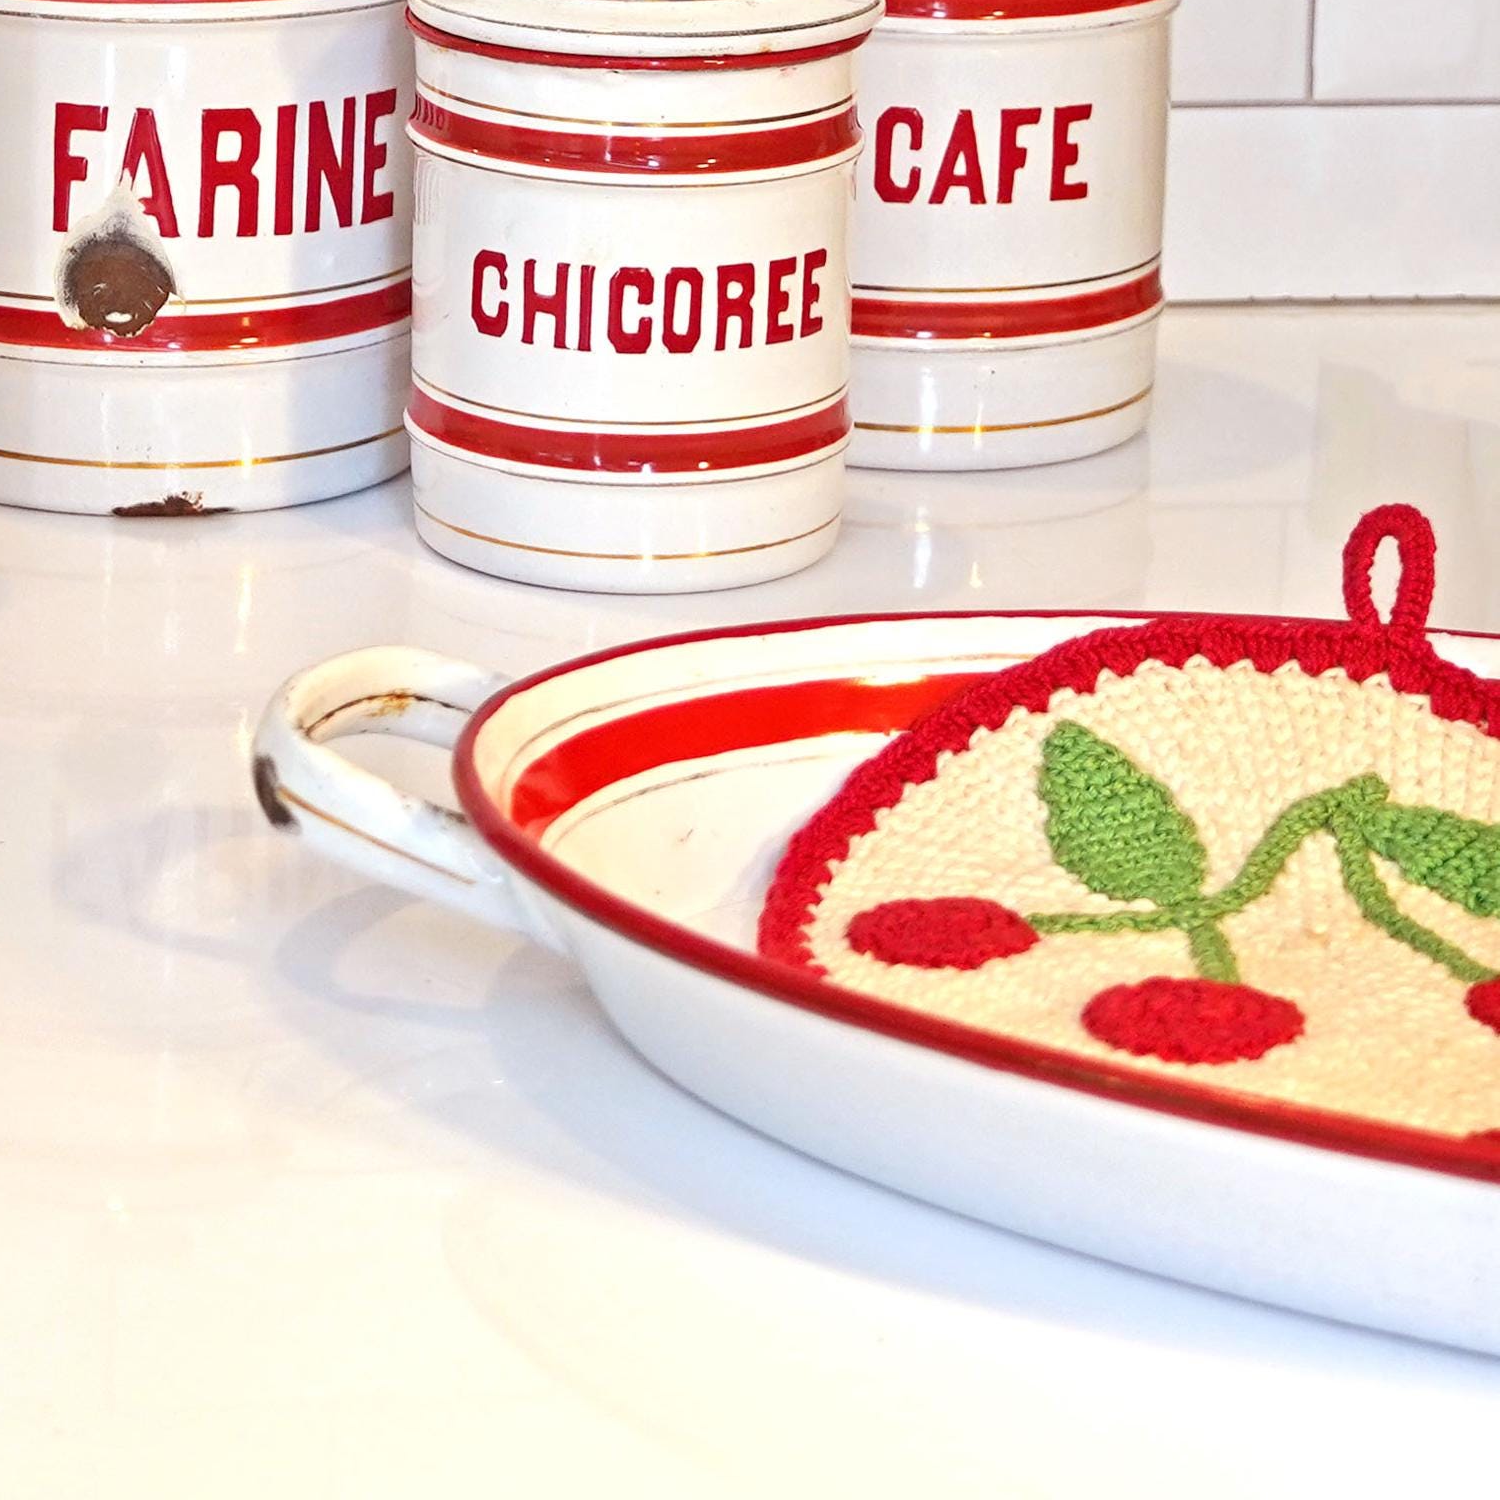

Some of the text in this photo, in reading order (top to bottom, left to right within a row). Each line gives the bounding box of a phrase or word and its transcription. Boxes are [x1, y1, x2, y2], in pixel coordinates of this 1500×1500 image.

[51, 87, 398, 239] FARINE
[873, 103, 1093, 206] CAFE
[470, 247, 828, 355] CHICOREE
